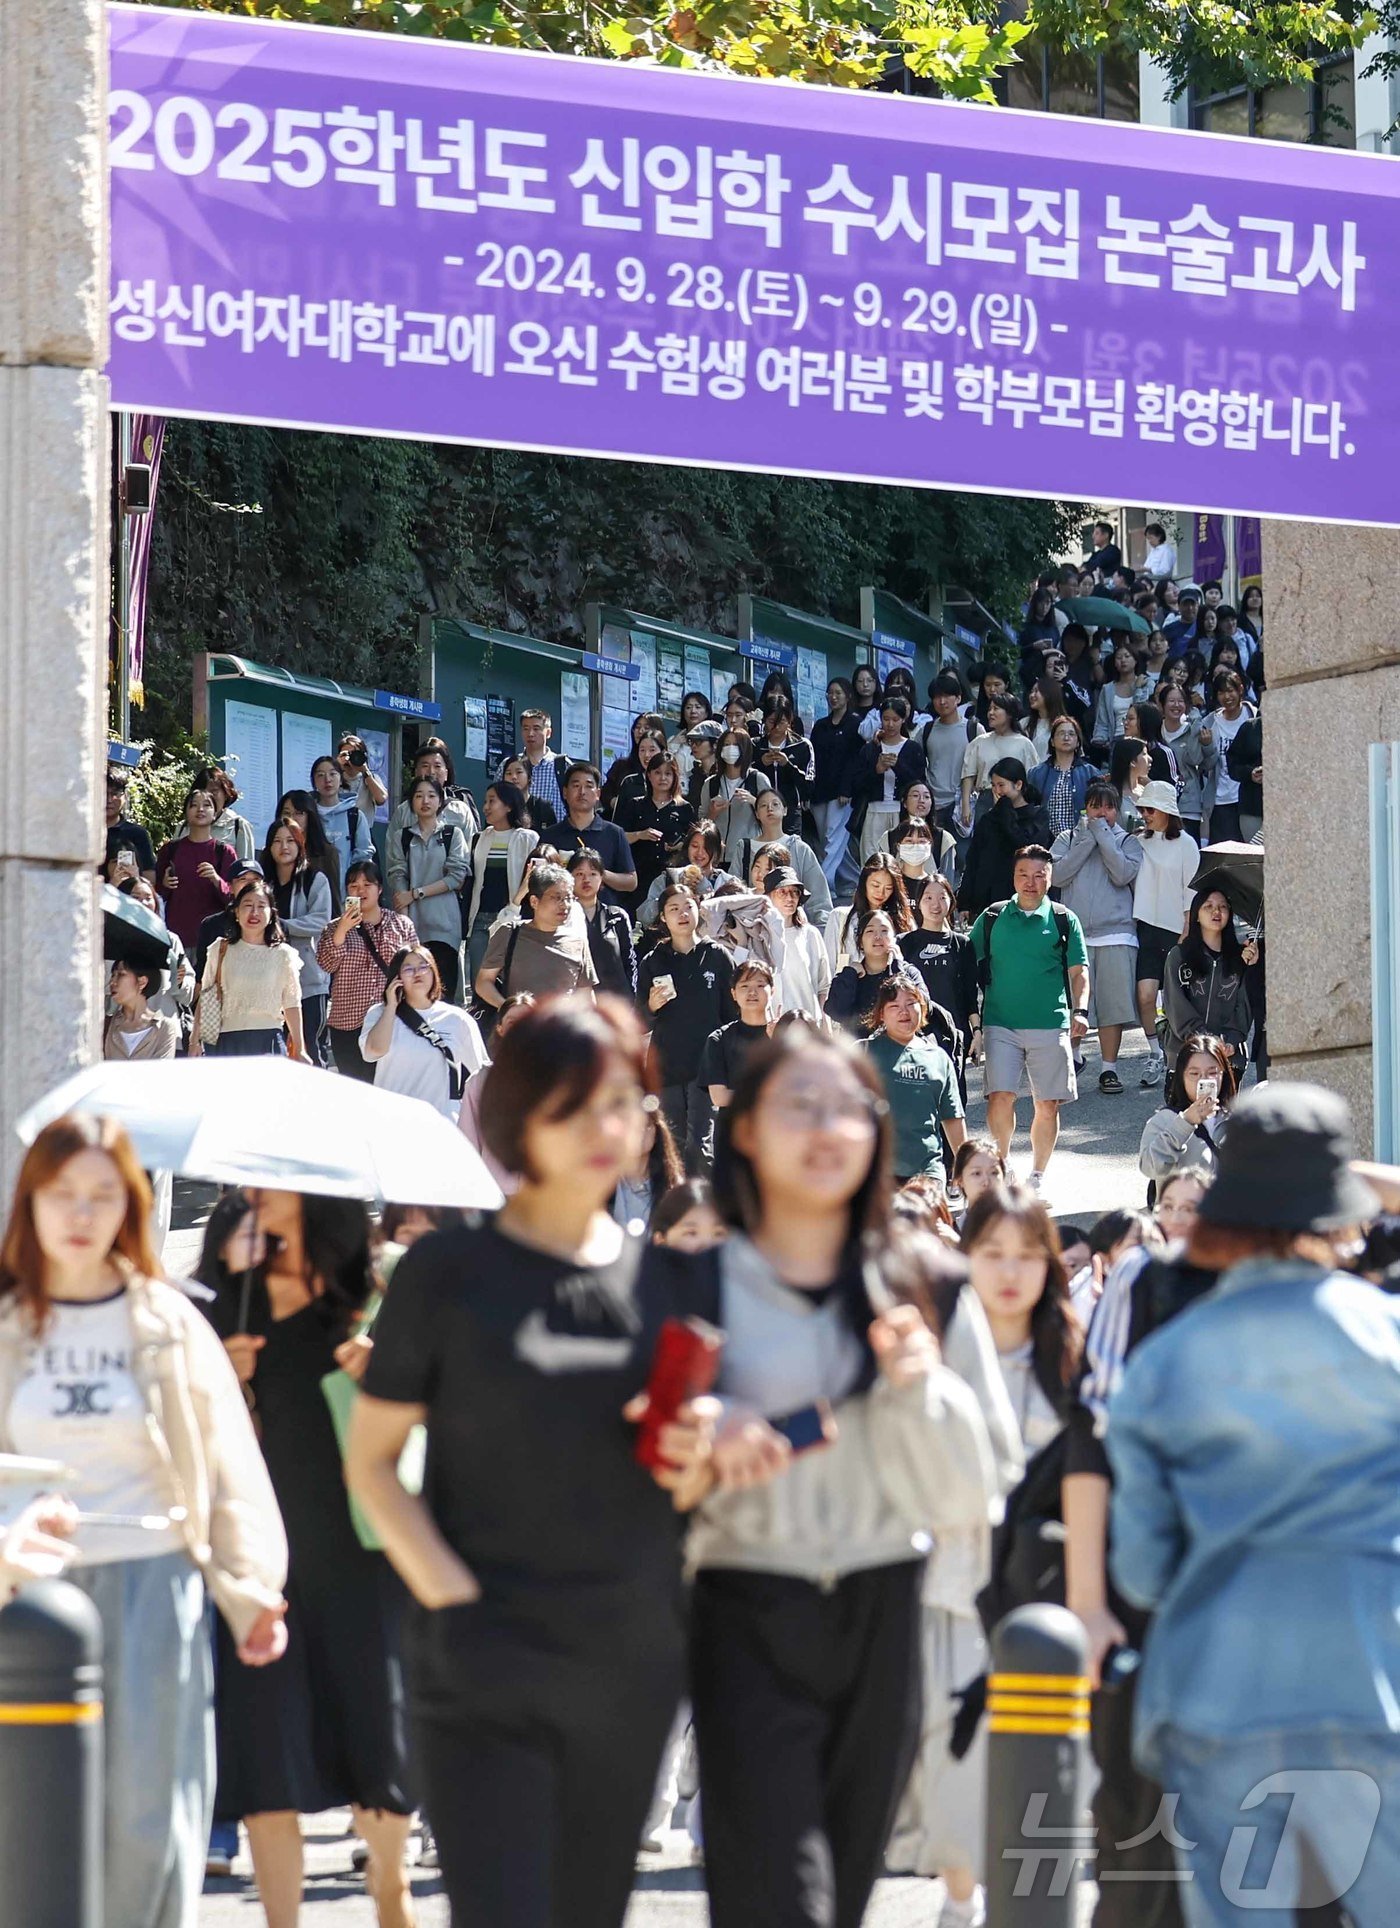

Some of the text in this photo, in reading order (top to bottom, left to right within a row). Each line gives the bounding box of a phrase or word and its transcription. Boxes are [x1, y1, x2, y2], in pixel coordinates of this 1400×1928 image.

[107, 88, 1366, 311] 2025학년도 신입학 수시모집 논술고사
[475, 242, 605, 299] 2024.
[616, 257, 656, 304] 9.
[108, 279, 1356, 460] 성신여자대학교에 오신 수험생 여러분 및 학부모님 환영합니다.
[409, 700, 424, 713] 게시판
